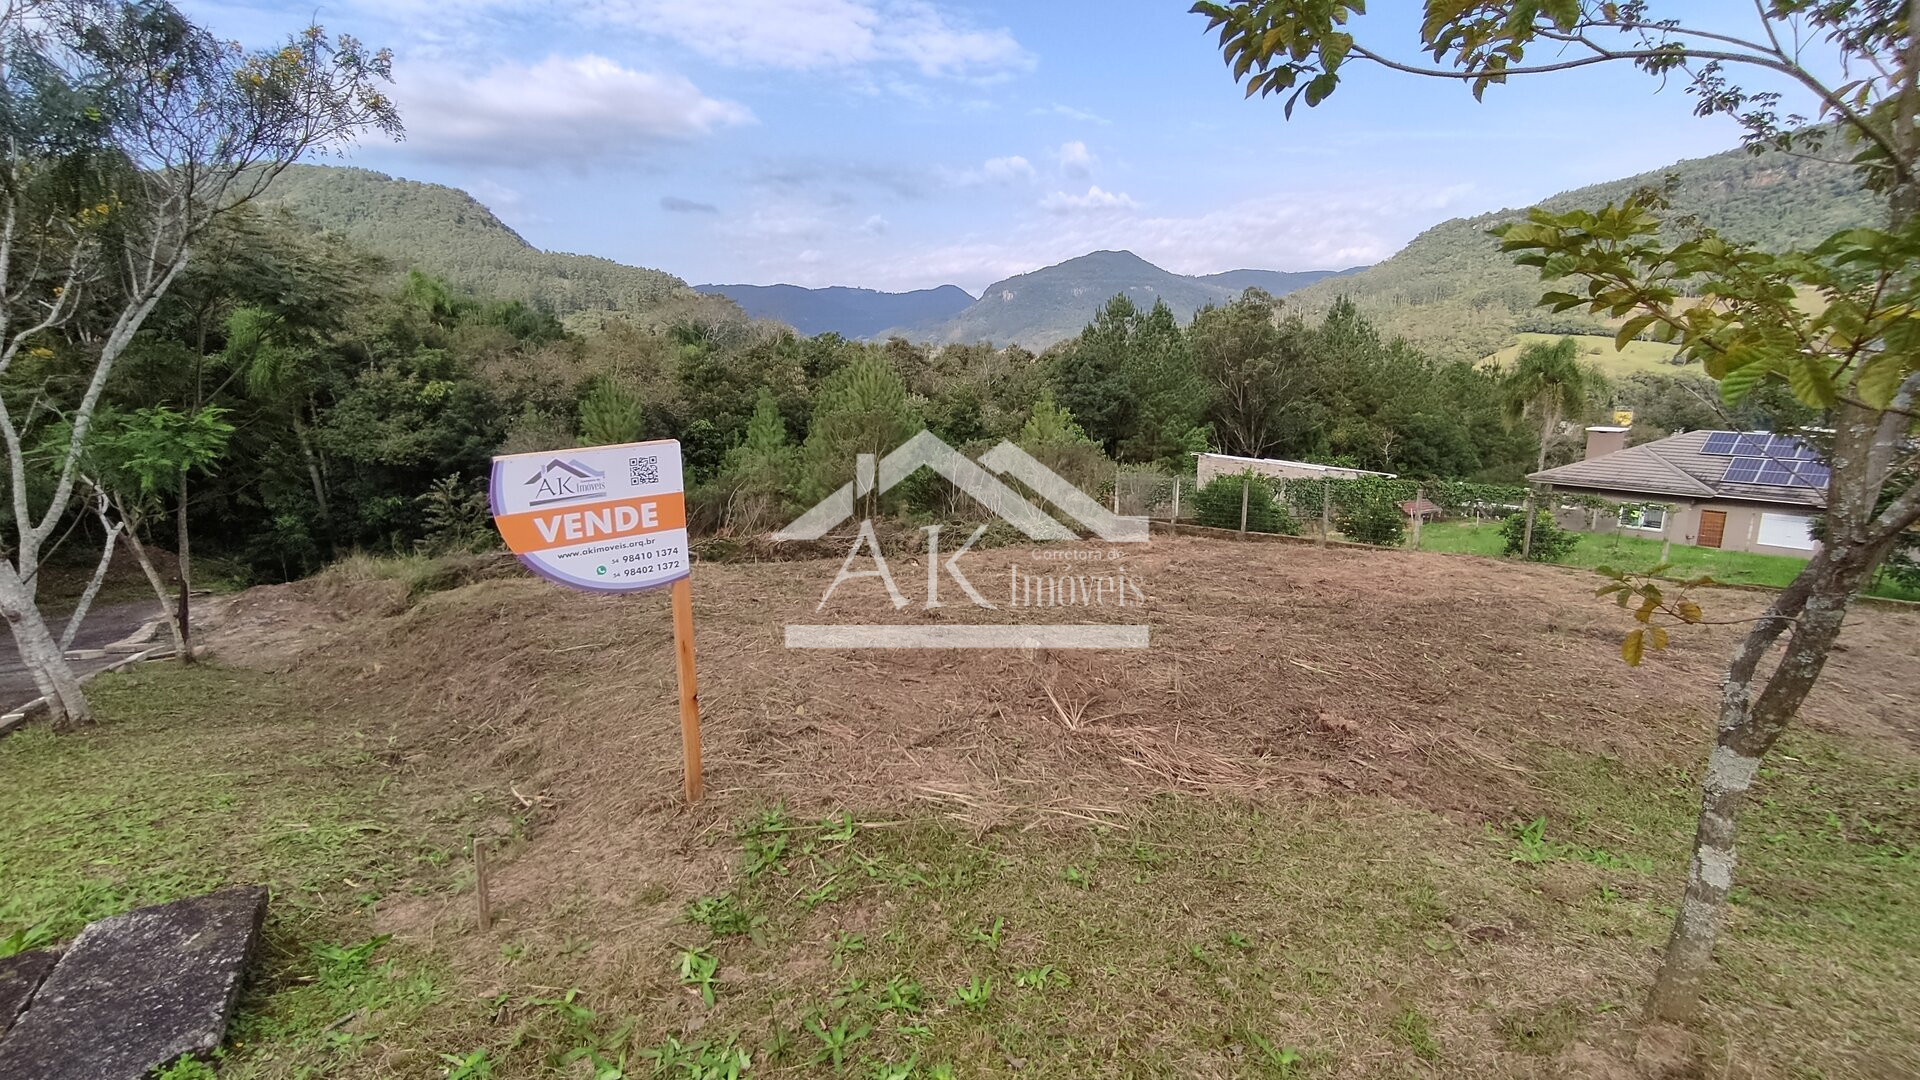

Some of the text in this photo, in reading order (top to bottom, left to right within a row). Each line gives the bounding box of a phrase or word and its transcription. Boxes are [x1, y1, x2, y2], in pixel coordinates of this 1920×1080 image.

[536, 476, 575, 499] AK
[533, 502, 659, 544] VENDE
[557, 538, 656, 560] www.akimoveis.arq.br
[622, 551, 653, 564] 98410
[656, 547, 679, 558] 1374
[624, 565, 654, 577] 98402
[657, 560, 680, 571] 1372
